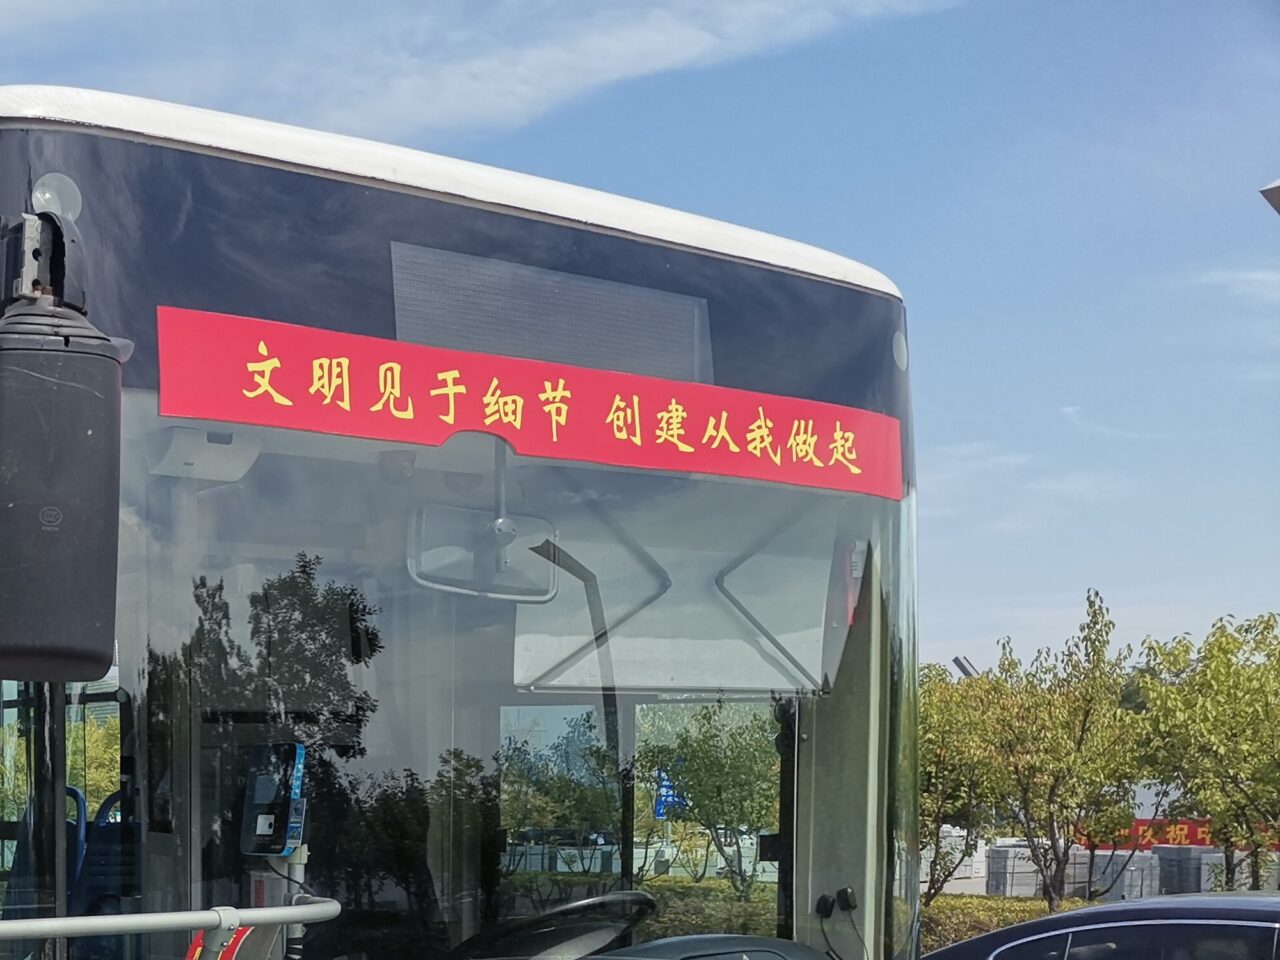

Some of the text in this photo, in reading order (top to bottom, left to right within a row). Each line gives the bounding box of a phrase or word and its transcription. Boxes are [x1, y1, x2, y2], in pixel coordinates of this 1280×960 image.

[241, 340, 863, 474] 文明见于细节 创建从我做起
